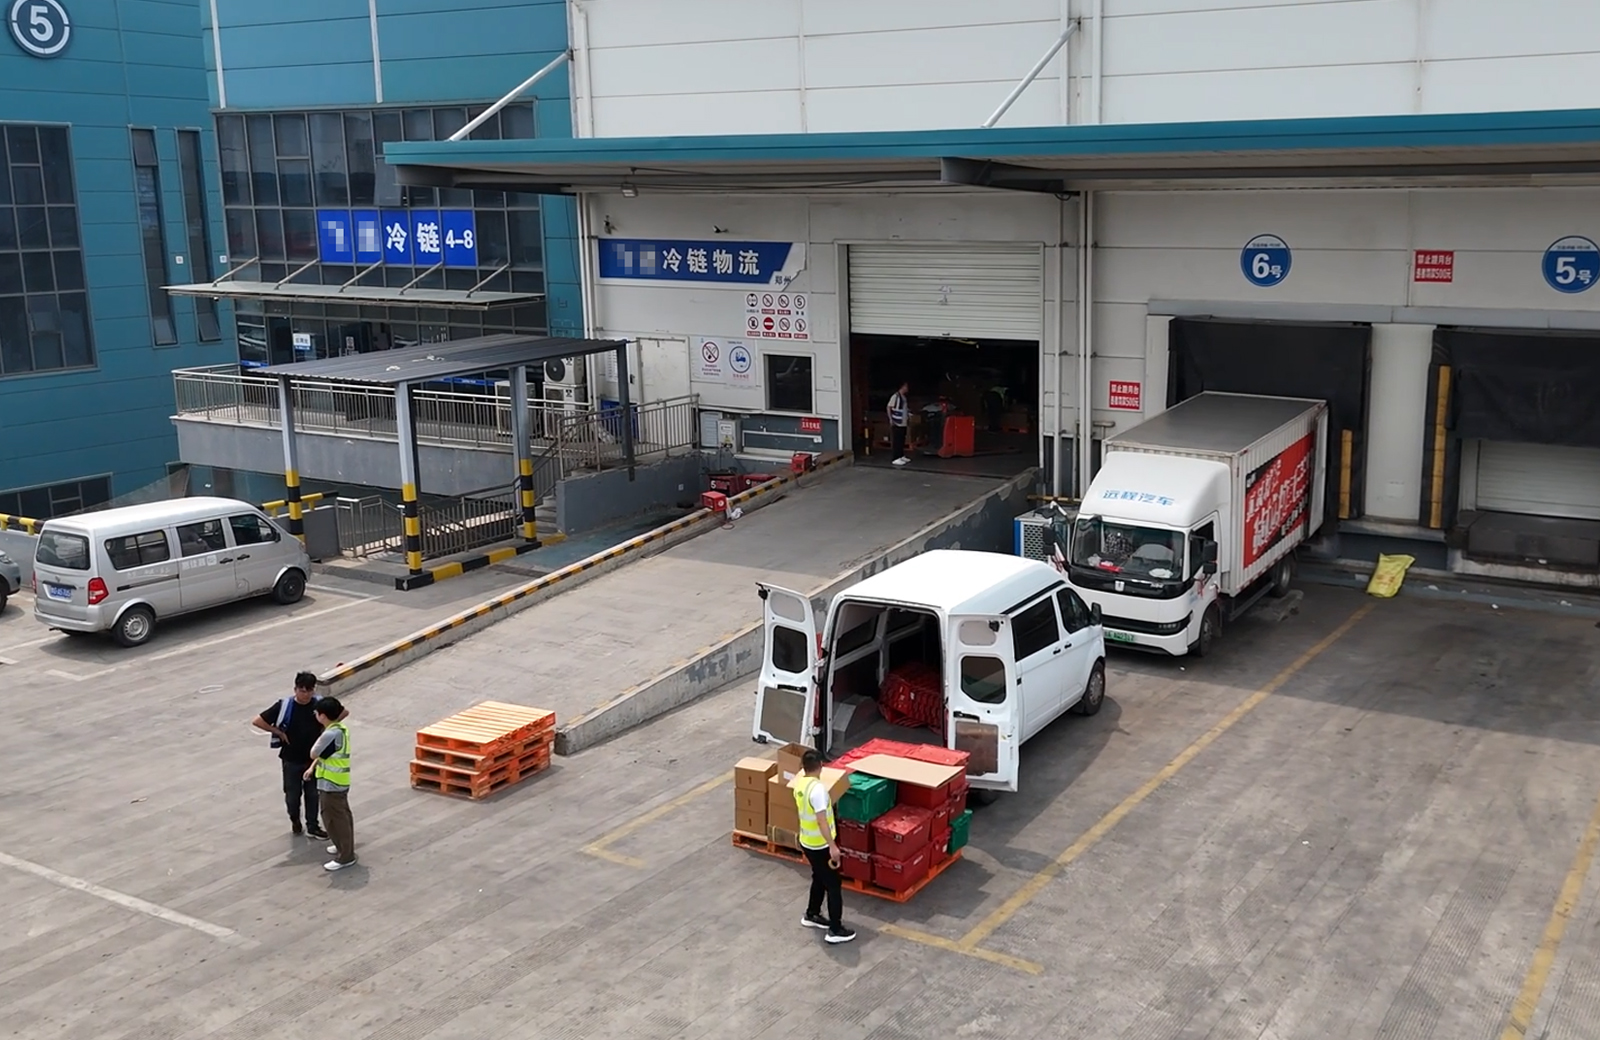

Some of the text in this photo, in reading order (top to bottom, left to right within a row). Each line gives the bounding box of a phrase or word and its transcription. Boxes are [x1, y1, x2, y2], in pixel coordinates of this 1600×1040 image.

[30, 5, 53, 41] 5
[386, 222, 440, 253] 冷链
[445, 229, 473, 249] 4-8
[662, 248, 761, 275] 冷链物流
[1252, 253, 1282, 278] 6号
[1556, 257, 1592, 284] 5号
[1103, 490, 1175, 505] 远程汽车
